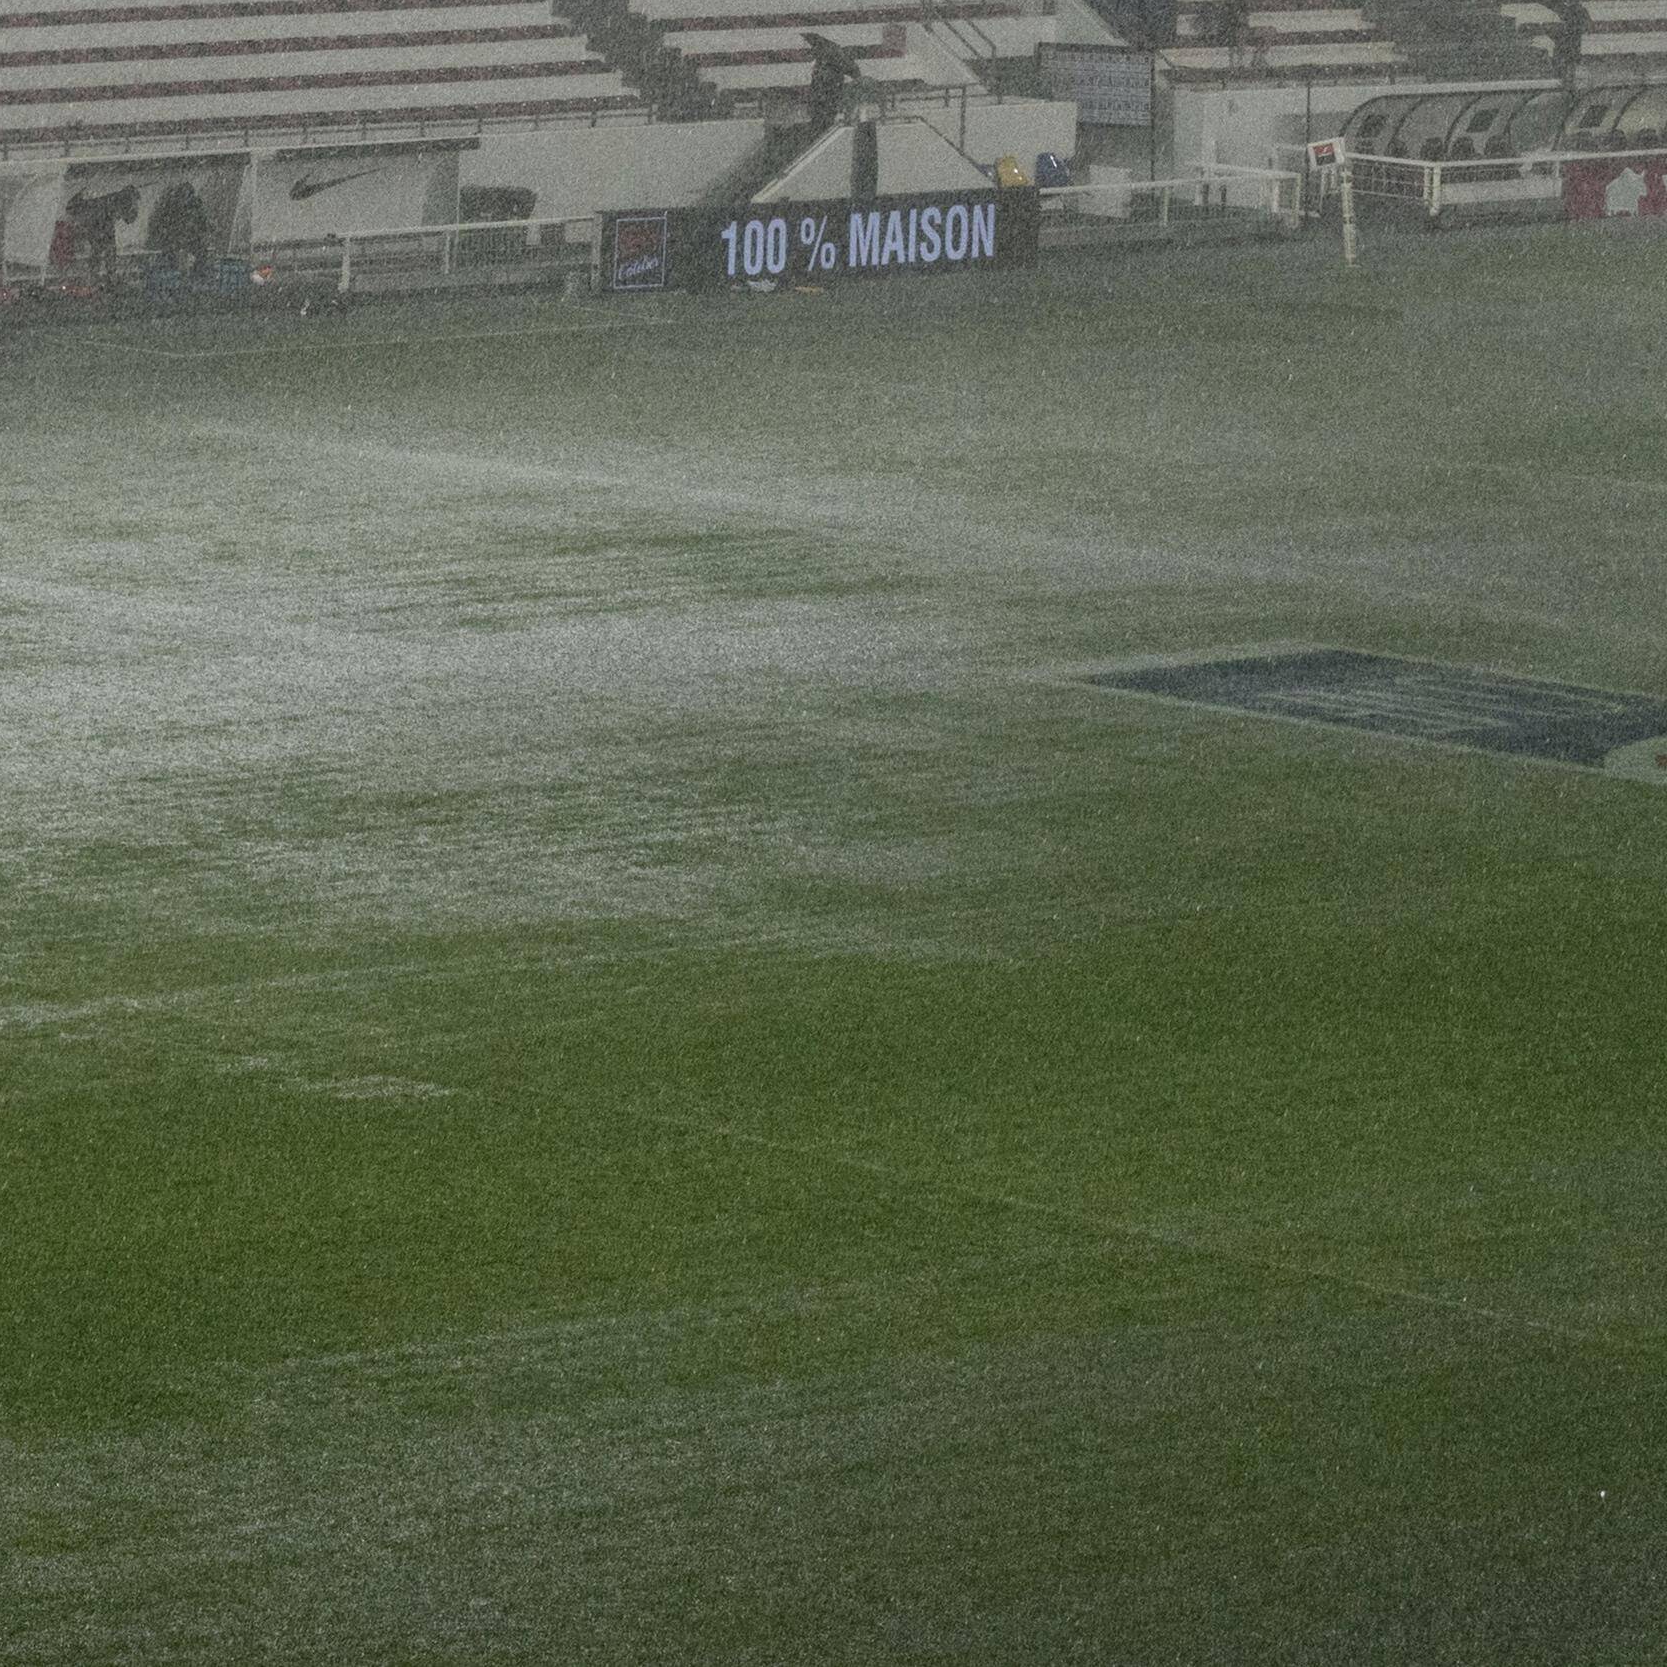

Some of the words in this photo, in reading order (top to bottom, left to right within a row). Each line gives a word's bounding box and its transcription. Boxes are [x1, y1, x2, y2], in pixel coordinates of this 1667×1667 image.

[721, 217, 787, 277] 100
[800, 215, 836, 273] %
[848, 203, 997, 268] MAISON
